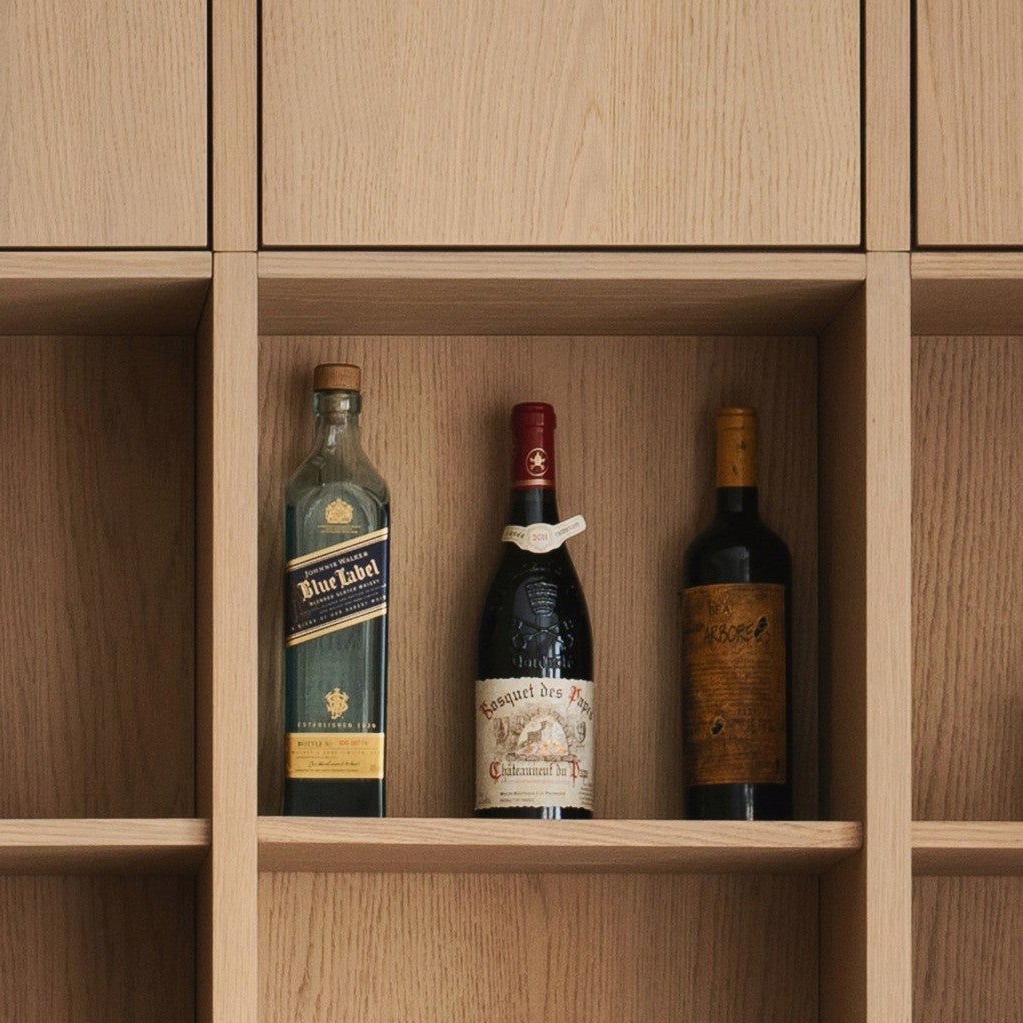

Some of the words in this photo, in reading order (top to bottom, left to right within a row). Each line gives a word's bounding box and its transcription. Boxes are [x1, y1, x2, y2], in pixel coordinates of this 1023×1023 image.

[298, 576, 337, 601] Blue
[334, 559, 380, 588] Label
[540, 682, 563, 699] des
[556, 762, 567, 777] du
